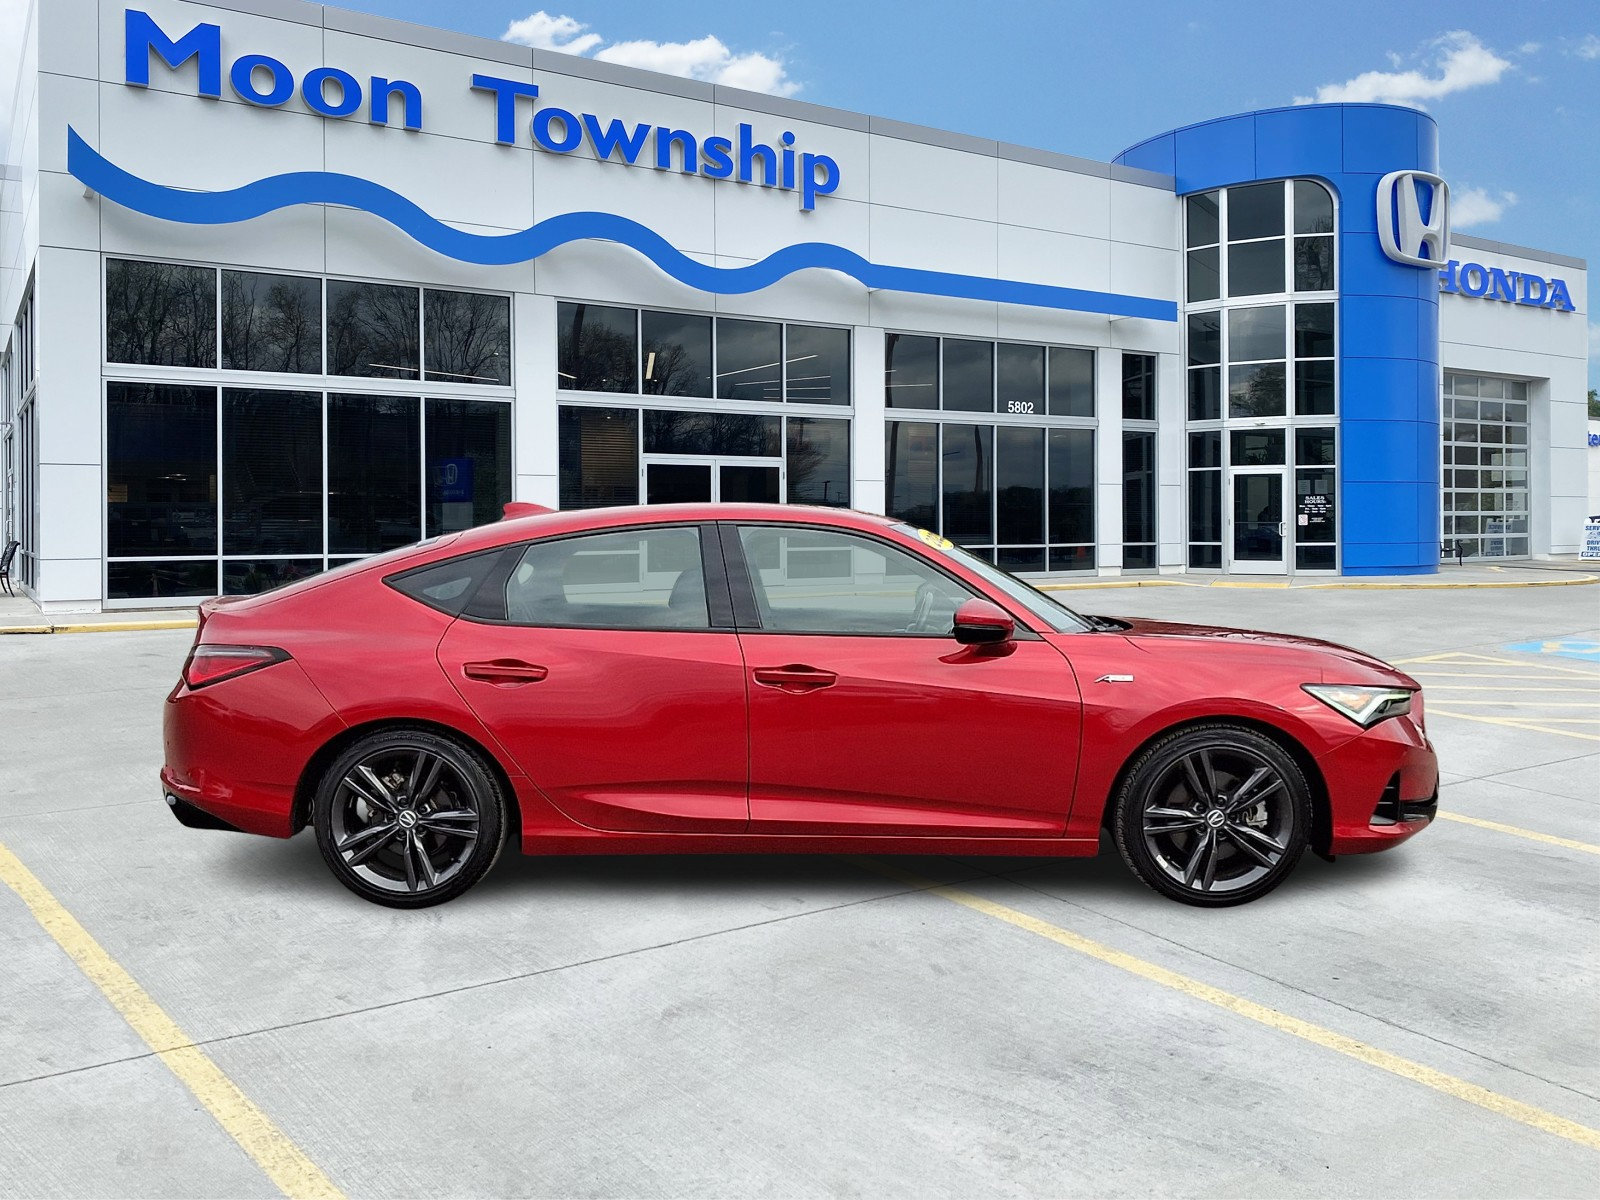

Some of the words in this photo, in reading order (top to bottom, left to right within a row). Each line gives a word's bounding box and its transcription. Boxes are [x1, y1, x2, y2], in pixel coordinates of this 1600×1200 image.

[125, 8, 422, 130] Moon
[470, 73, 841, 213] Township
[1007, 400, 1034, 414] 5802
[1588, 430, 1600, 447] te
